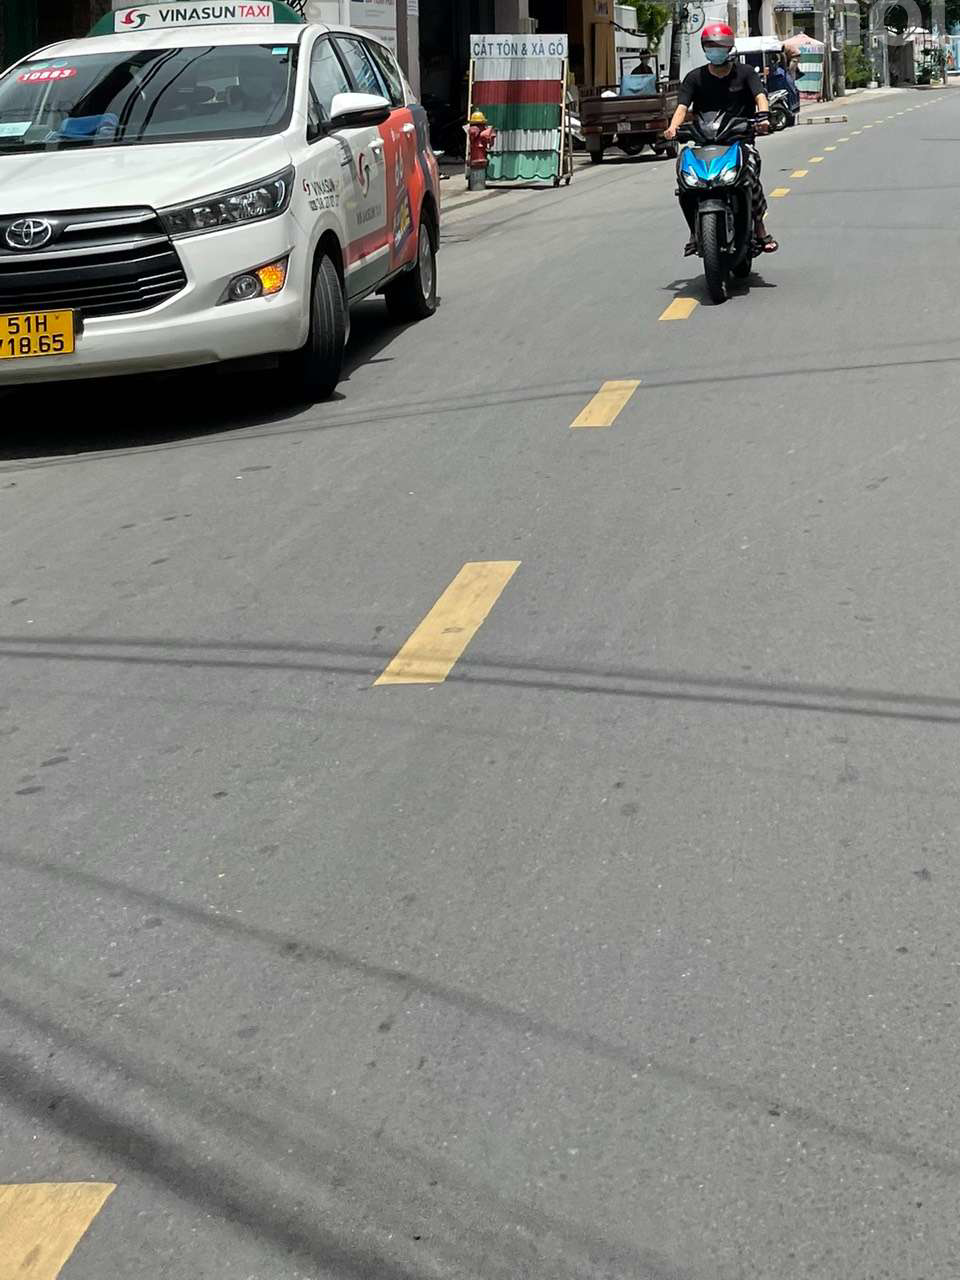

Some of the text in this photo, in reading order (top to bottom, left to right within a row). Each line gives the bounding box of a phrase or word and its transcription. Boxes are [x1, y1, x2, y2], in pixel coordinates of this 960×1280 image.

[159, 5, 270, 23] VINASUN TAXI
[521, 43, 528, 56] &
[8, 314, 47, 335] 51H
